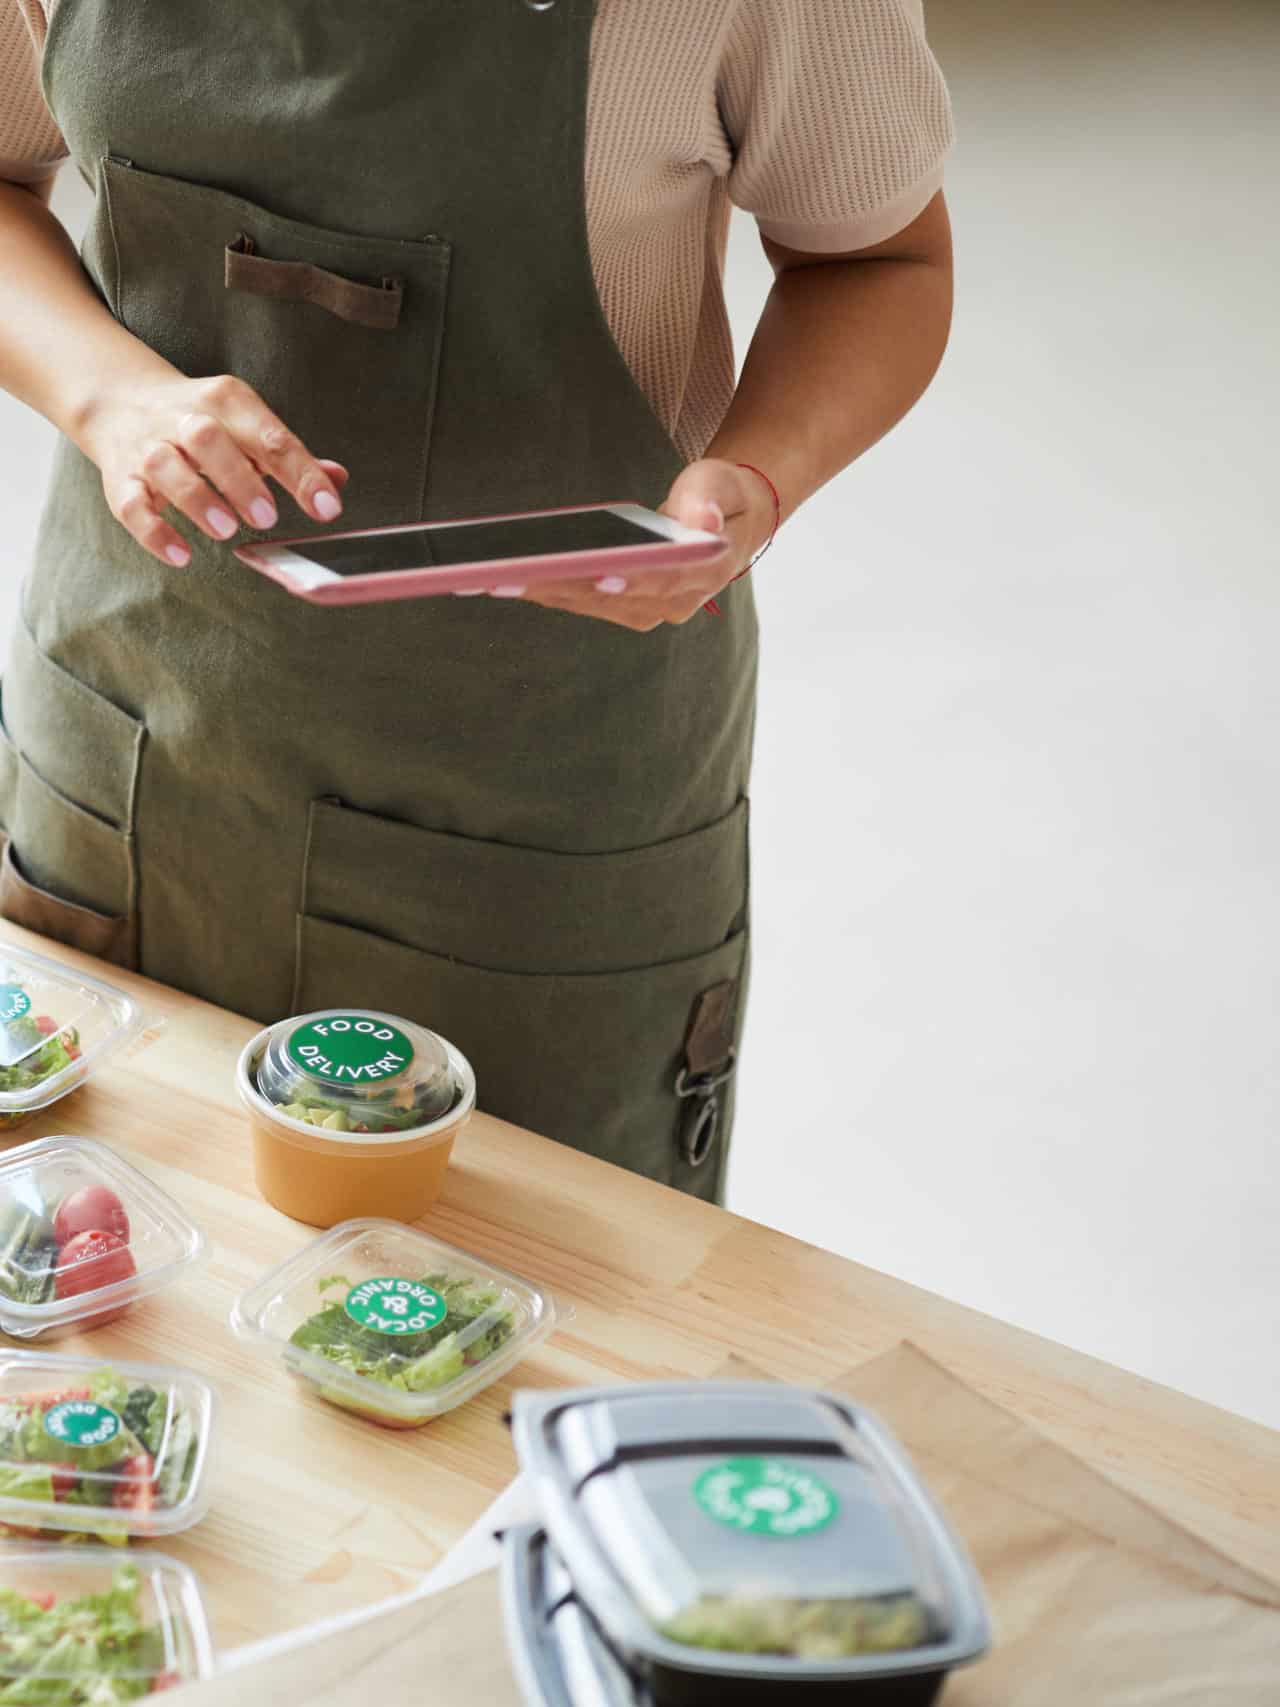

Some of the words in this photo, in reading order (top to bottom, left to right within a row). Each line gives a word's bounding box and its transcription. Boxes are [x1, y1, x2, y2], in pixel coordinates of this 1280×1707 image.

[312, 1020, 394, 1041] FOOD
[298, 1045, 404, 1079] DELIVERY
[351, 1280, 436, 1306] ORGANIC
[381, 1295, 408, 1315] &
[365, 1311, 437, 1332] LOCAL
